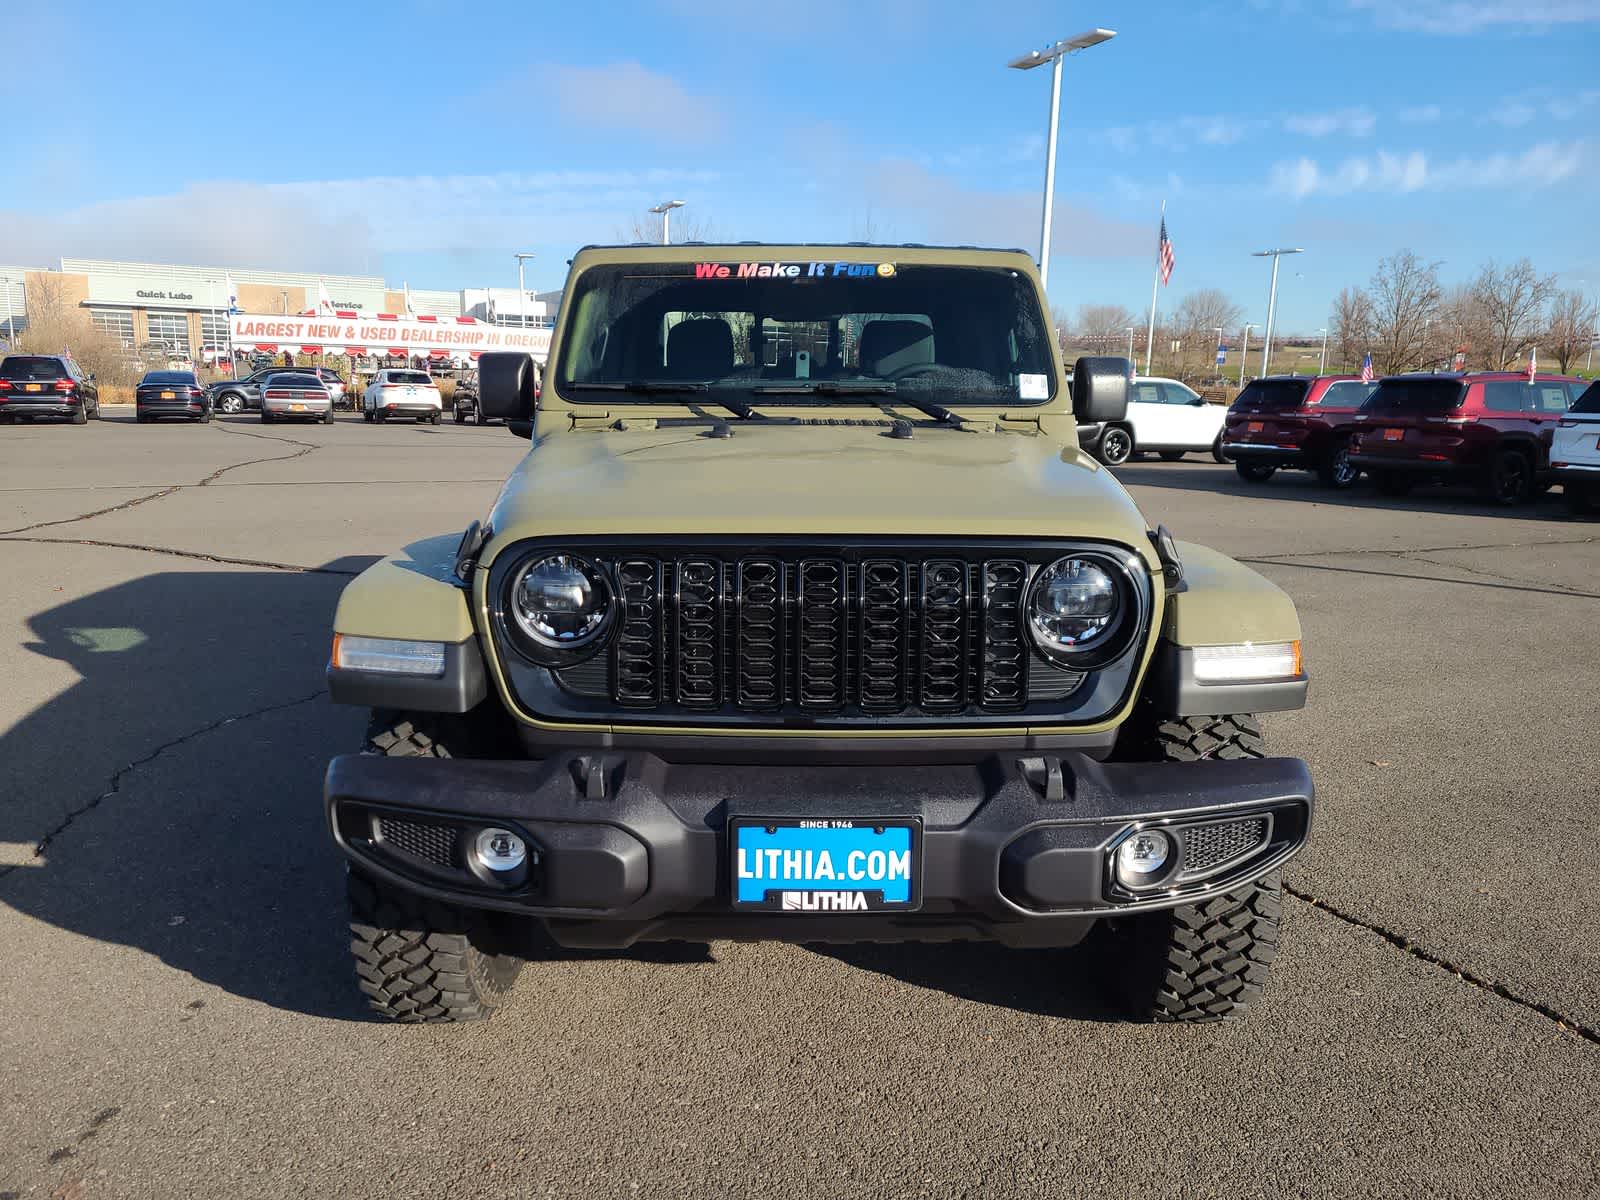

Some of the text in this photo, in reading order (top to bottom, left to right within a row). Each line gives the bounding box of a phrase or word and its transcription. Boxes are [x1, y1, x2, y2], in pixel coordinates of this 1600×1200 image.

[695, 262, 876, 278] We Make It Fun
[136, 290, 193, 300] Quick Lube
[236, 321, 304, 338] LARGEST
[307, 324, 341, 339] NEW
[345, 326, 356, 339] &
[360, 327, 397, 340] USED
[401, 328, 484, 345] DEALERSHIP
[487, 333, 500, 345] IN
[800, 821, 853, 829] SINCE 1946
[738, 848, 911, 881] LITHIA.COM
[802, 891, 868, 910] LITHIA
